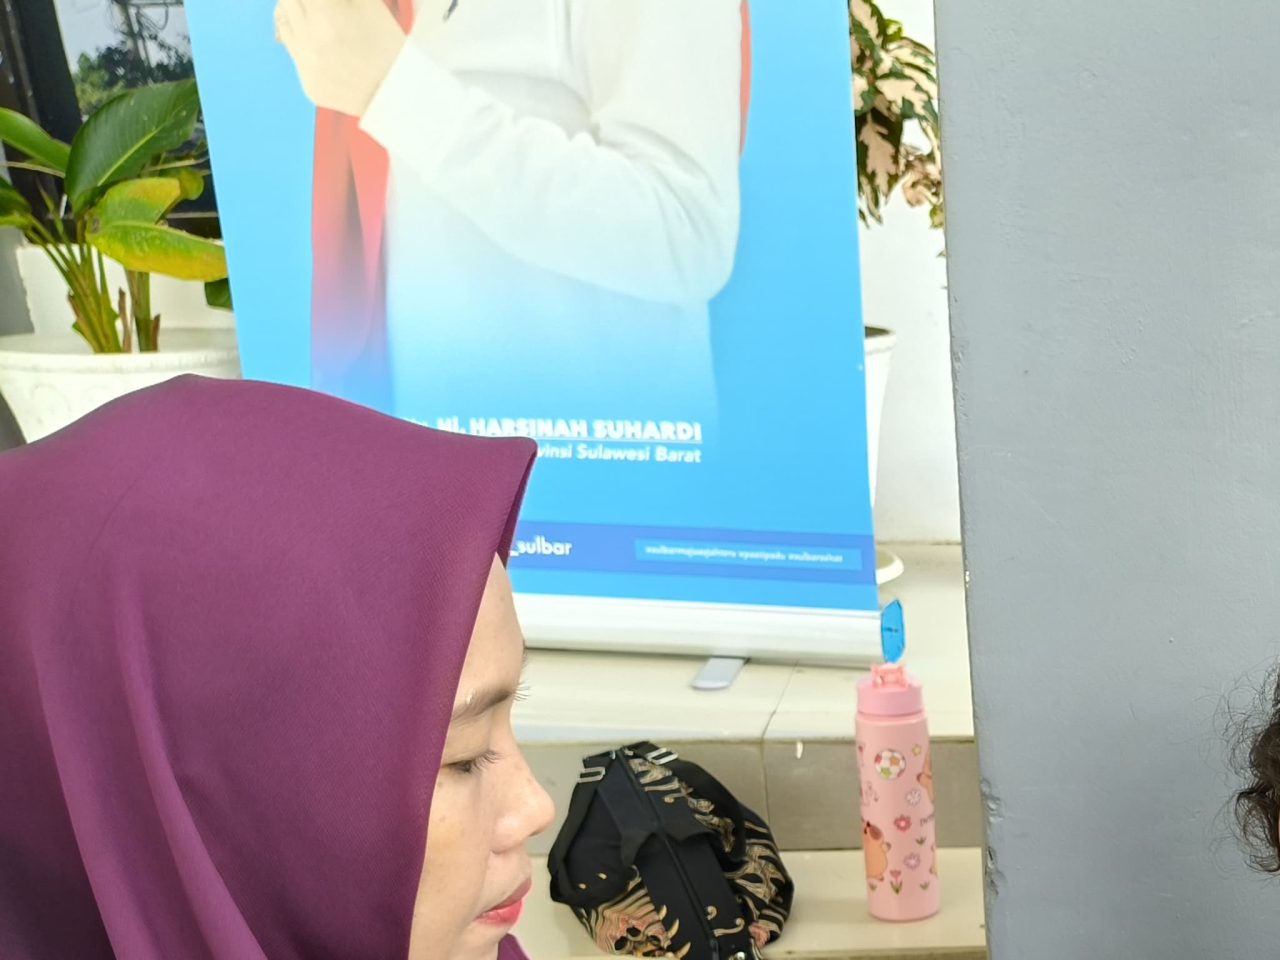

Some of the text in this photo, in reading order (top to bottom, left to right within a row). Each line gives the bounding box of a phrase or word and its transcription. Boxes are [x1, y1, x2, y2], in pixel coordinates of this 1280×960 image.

[593, 418, 702, 441] SUHARDI
[538, 443, 702, 463] vinsi Sulawesi Barat
[510, 535, 572, 556] _sulbar
